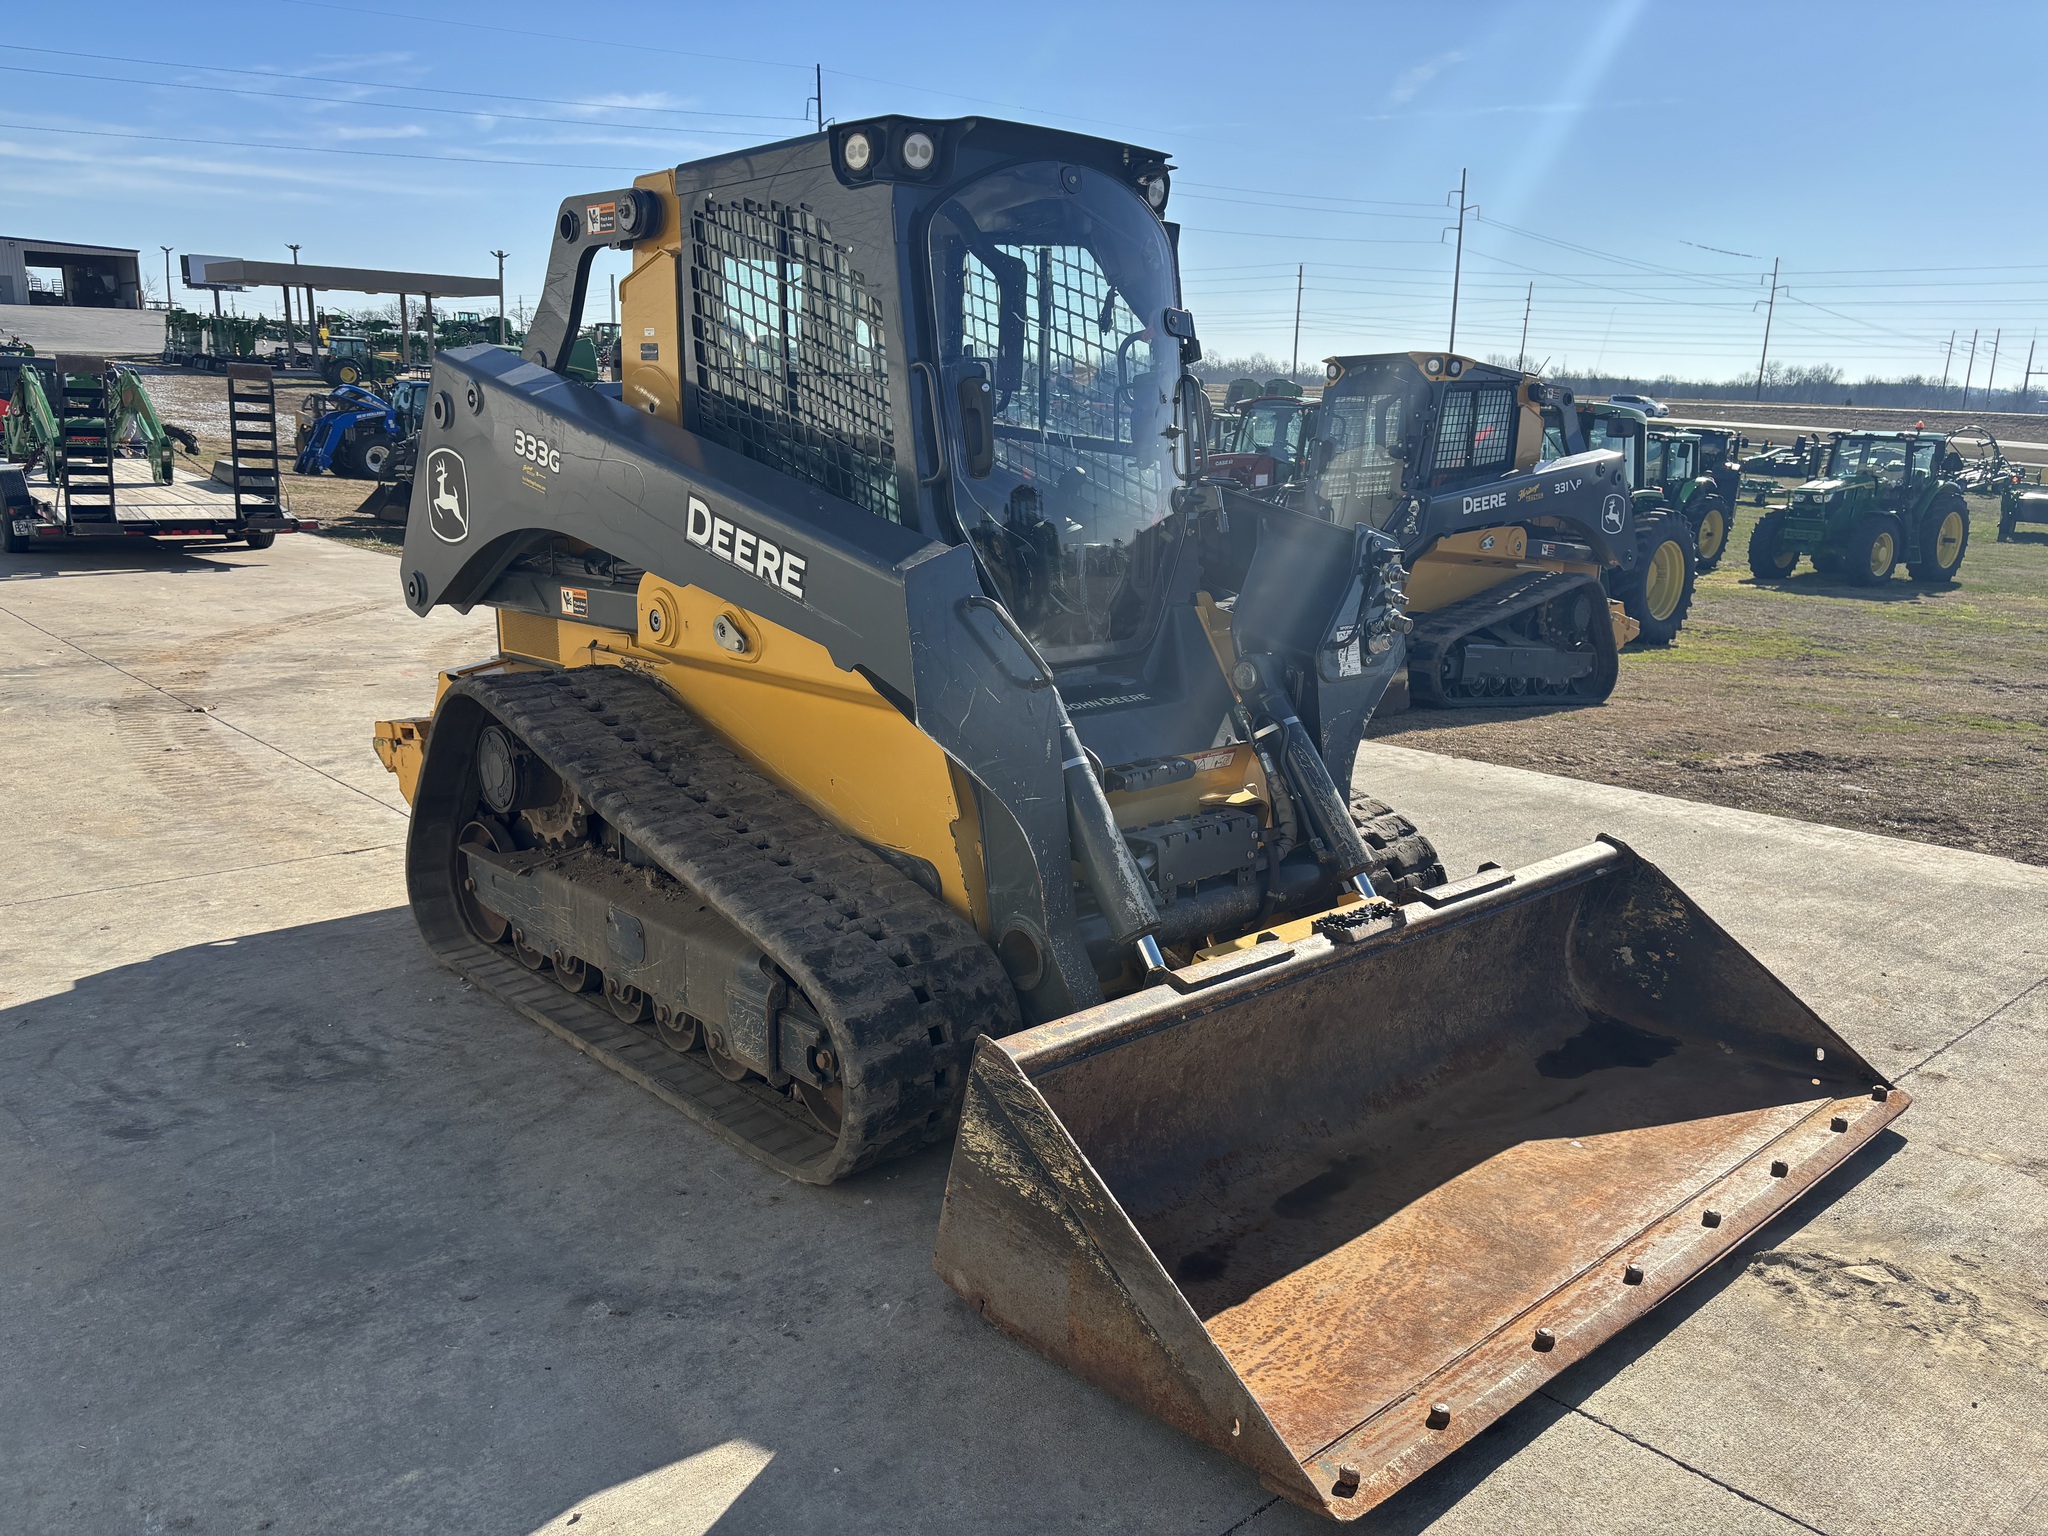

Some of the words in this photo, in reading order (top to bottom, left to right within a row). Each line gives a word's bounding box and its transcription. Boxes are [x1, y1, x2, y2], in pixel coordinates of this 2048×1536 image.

[514, 429, 560, 474] 333G
[1462, 492, 1507, 515] DEERE
[686, 496, 806, 599] DEERE
[1063, 700, 1104, 711] JOHN
[1099, 693, 1152, 705] DEERE
